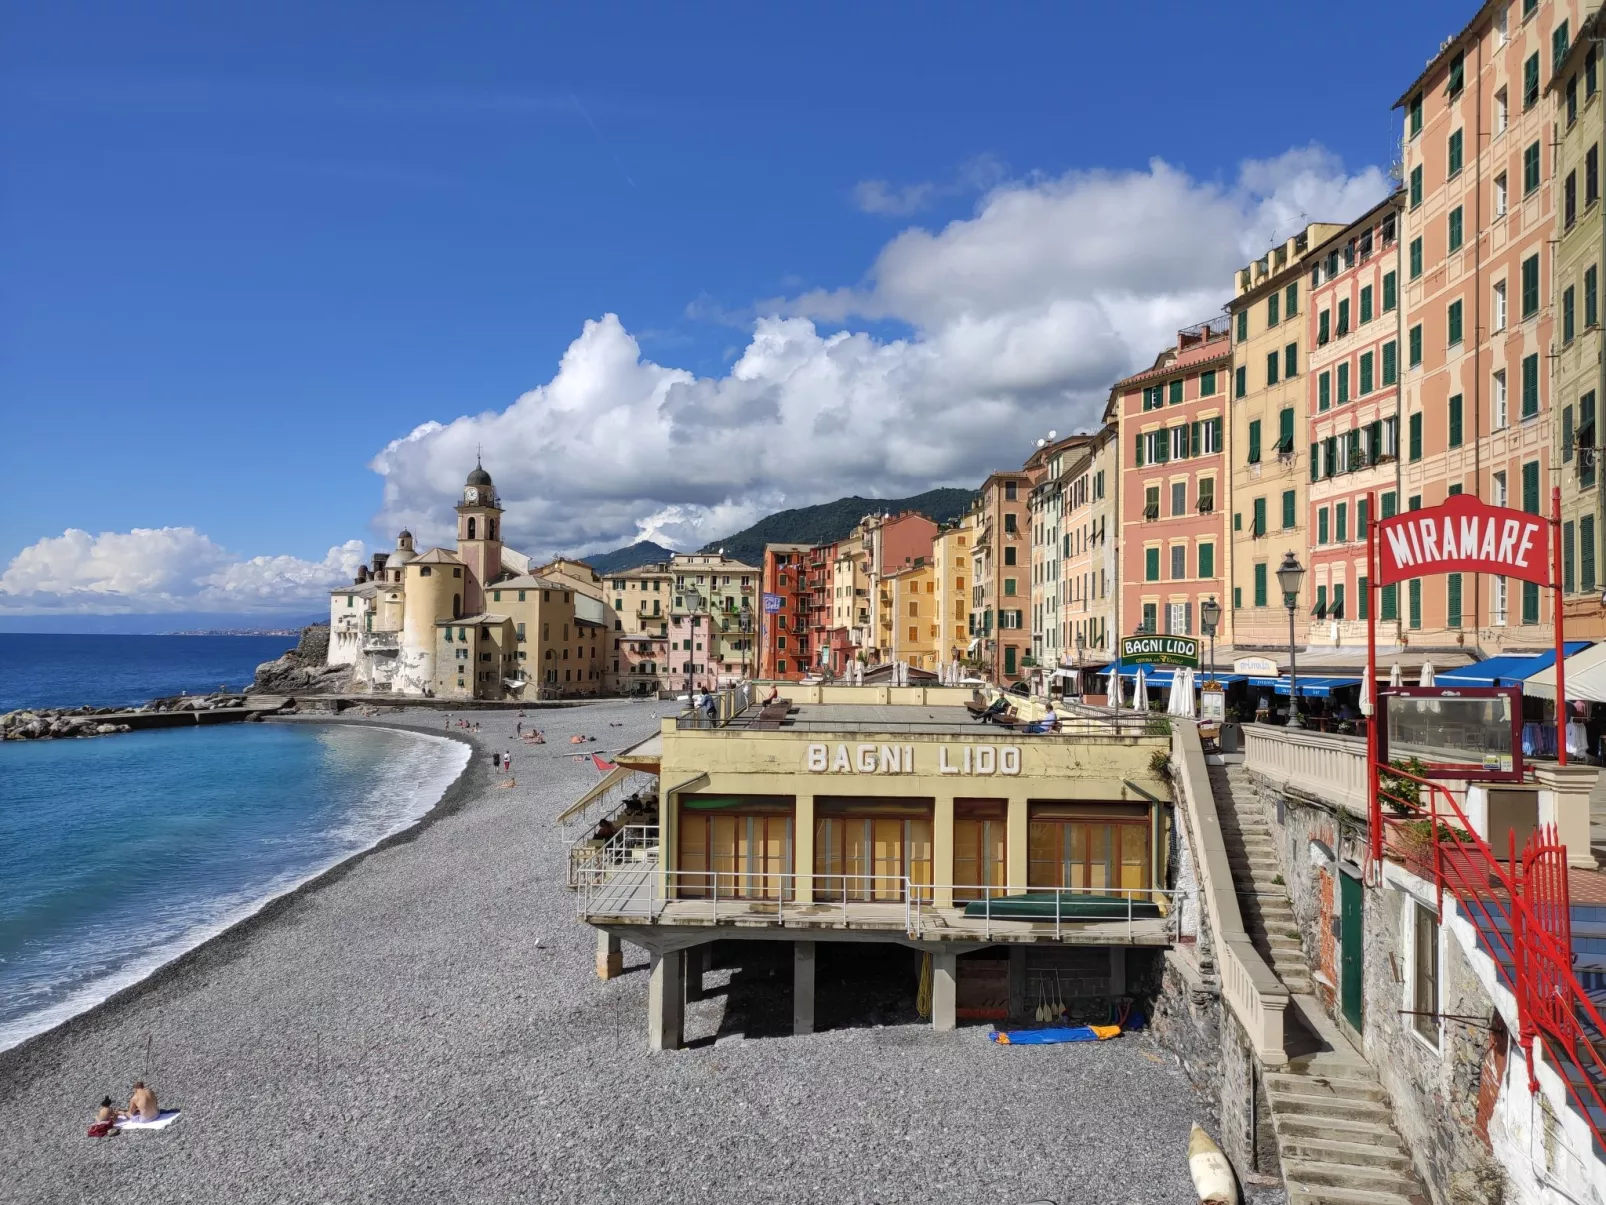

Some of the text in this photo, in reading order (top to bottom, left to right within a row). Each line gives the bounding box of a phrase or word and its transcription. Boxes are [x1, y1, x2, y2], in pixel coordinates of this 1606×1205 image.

[1385, 516, 1539, 569] MIRAMARE
[1125, 639, 1195, 656] BAGNI LIDO
[808, 744, 1023, 776] BAGNI LIDO
